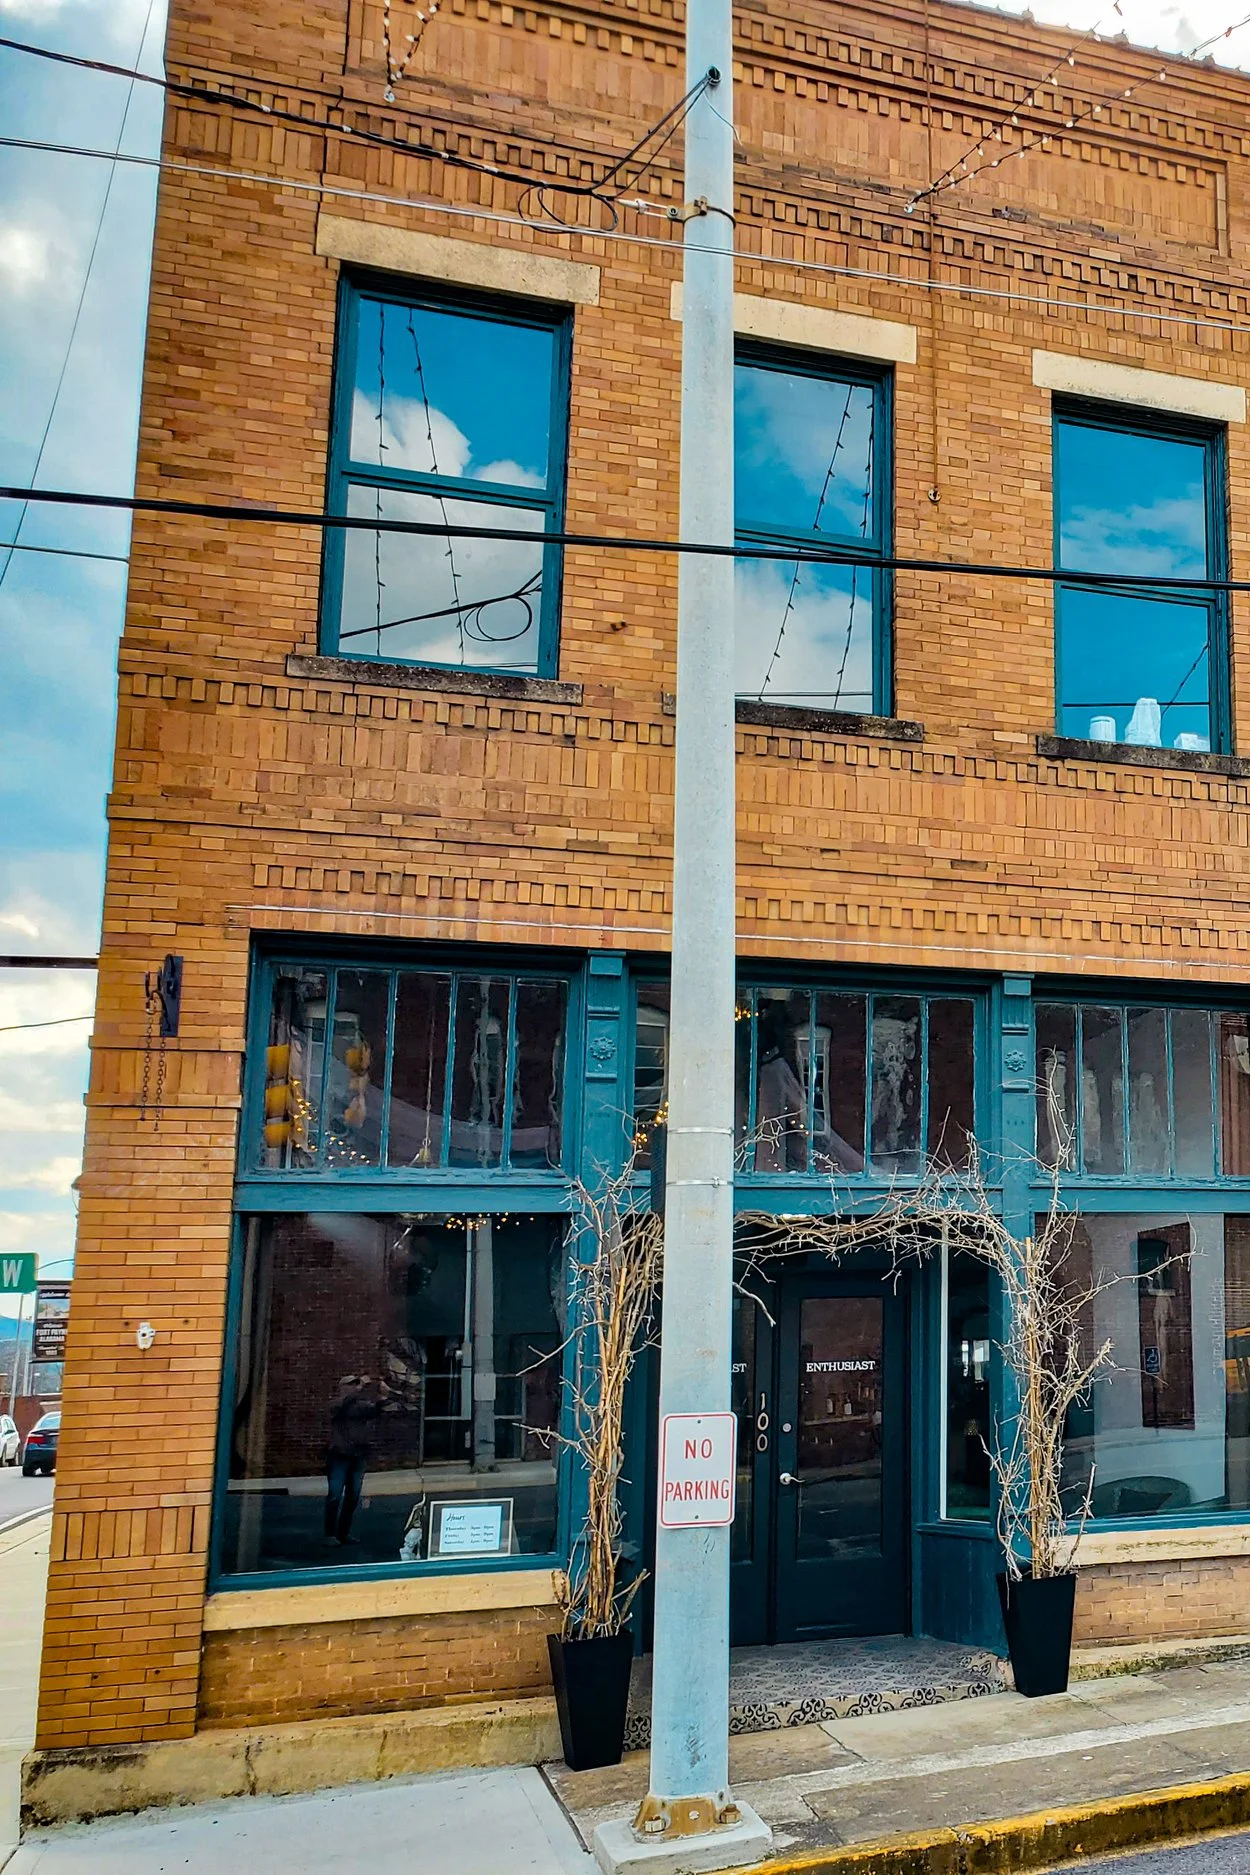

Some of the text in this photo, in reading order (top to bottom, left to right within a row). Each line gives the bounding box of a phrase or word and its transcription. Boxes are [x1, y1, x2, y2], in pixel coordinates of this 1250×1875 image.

[2, 1259, 23, 1287] W
[806, 1361, 876, 1373] ENTHUSIAST
[757, 1392, 770, 1452] 100
[684, 1438, 713, 1459] NO
[665, 1479, 730, 1502] PARKING
[446, 1513, 465, 1521] Hours
